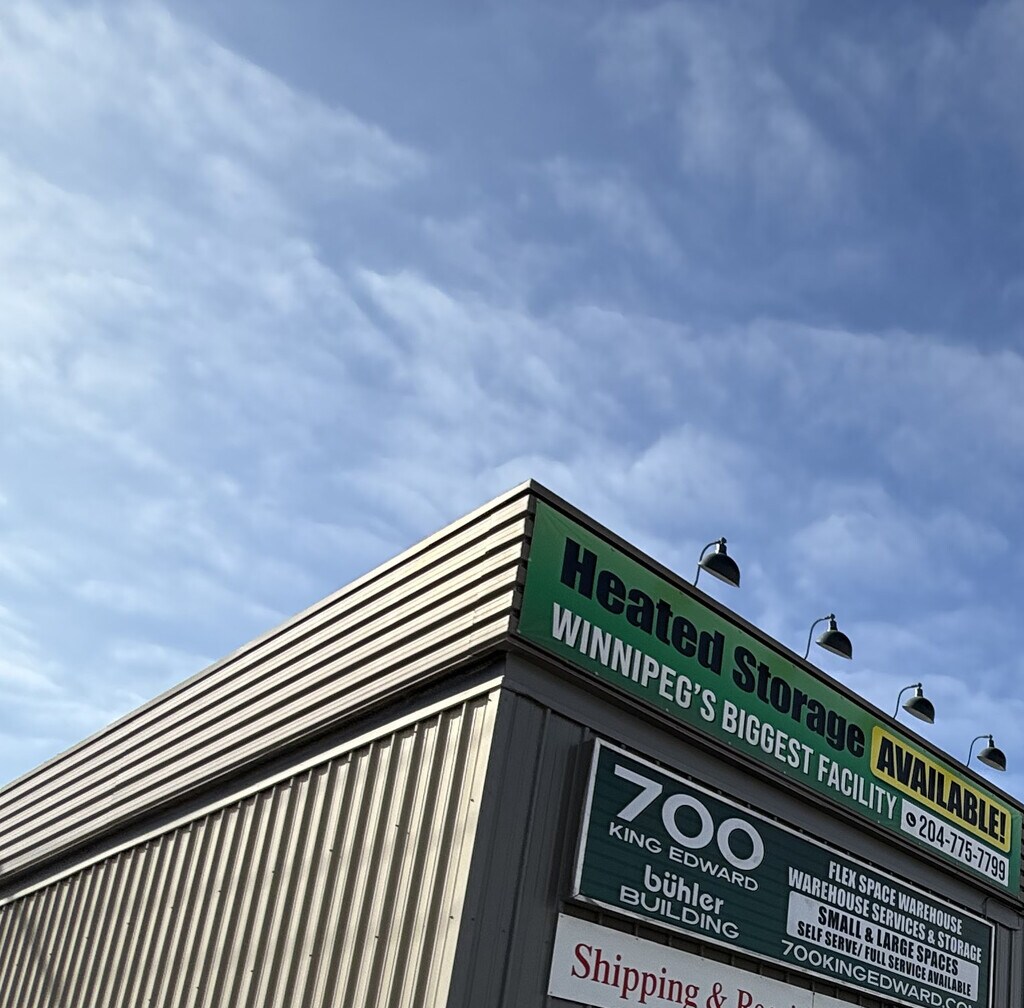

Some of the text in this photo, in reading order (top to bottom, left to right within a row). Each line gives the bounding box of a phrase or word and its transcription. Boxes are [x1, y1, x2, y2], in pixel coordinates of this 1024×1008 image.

[560, 536, 865, 757] Heated Storage
[552, 602, 898, 820] WINNIPEG'S BIGGEST FACILITY
[614, 764, 765, 870] 700
[876, 736, 1007, 844] AVAILABLE!
[609, 822, 759, 892] KING EDWARD
[918, 815, 1007, 882] 204-775-7799
[619, 885, 740, 939] BUILDING
[644, 864, 724, 915] bühler
[788, 866, 982, 964] WAREHOUSE SERVICES & STORAGE
[828, 860, 963, 936] FLEX SPACE WAREHOUSE
[797, 920, 972, 997] SELF SERVE/ FULL SERVICE AVAILABLE
[818, 906, 959, 976] SMALL & LARGE SPACES
